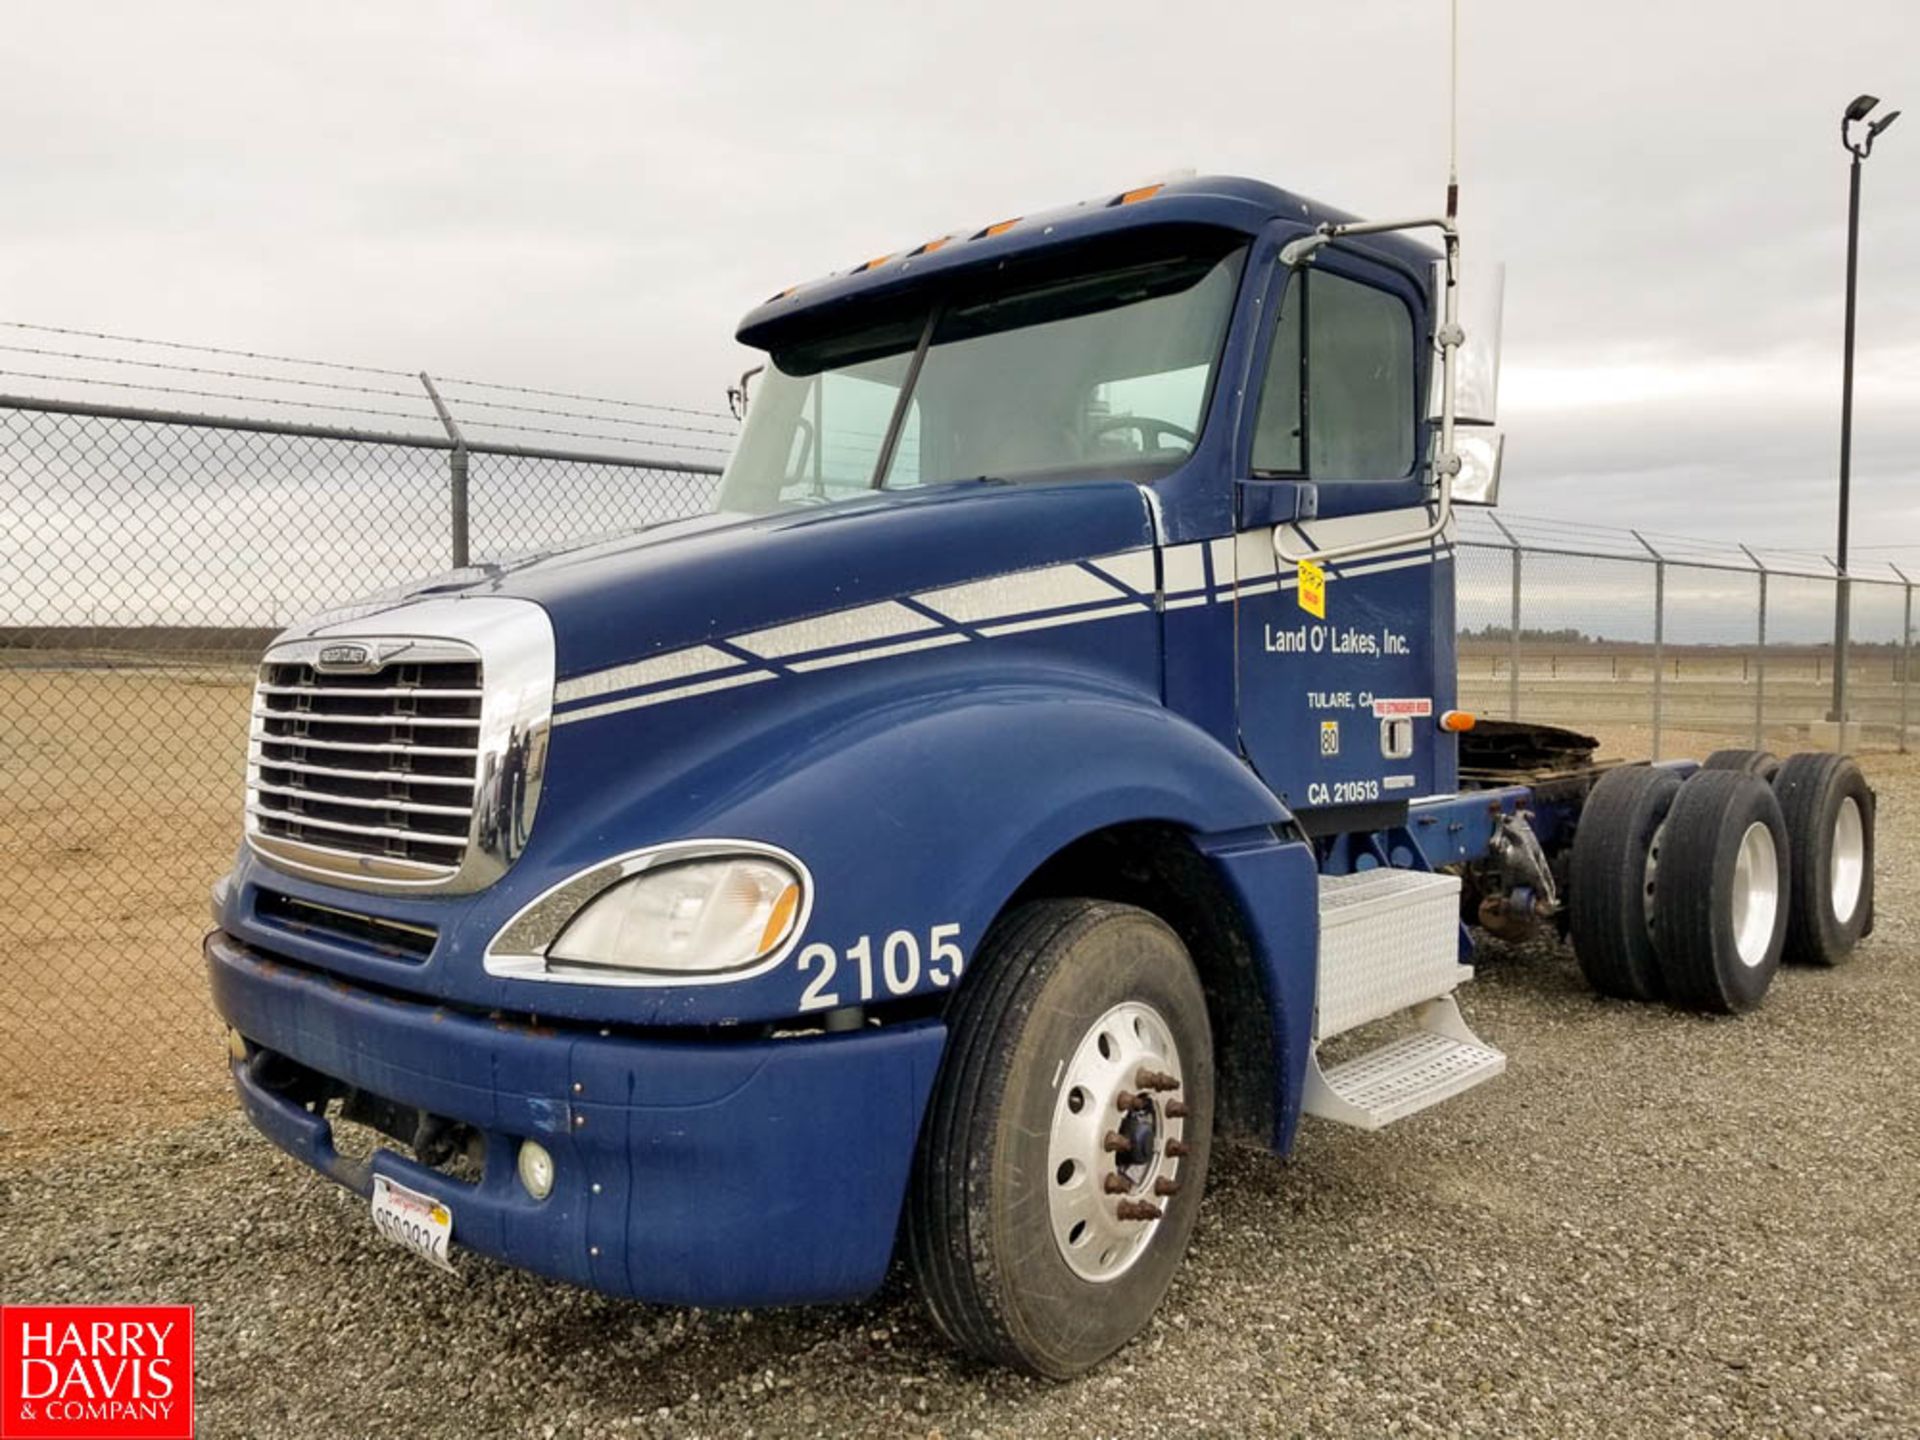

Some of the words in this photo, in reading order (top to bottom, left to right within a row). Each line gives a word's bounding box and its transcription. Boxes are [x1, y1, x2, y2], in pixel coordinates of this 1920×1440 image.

[1265, 624, 1306, 653] Land
[1311, 627, 1328, 653] O'
[1331, 627, 1381, 658] Lakes,
[1384, 629, 1410, 655] Inc.
[1307, 692, 1355, 710] TULARE,
[1358, 693, 1374, 708] CA
[1322, 729, 1338, 753] 80
[1308, 784, 1329, 805] CA
[1334, 782, 1379, 804] 210513
[797, 922, 964, 1012] 2105
